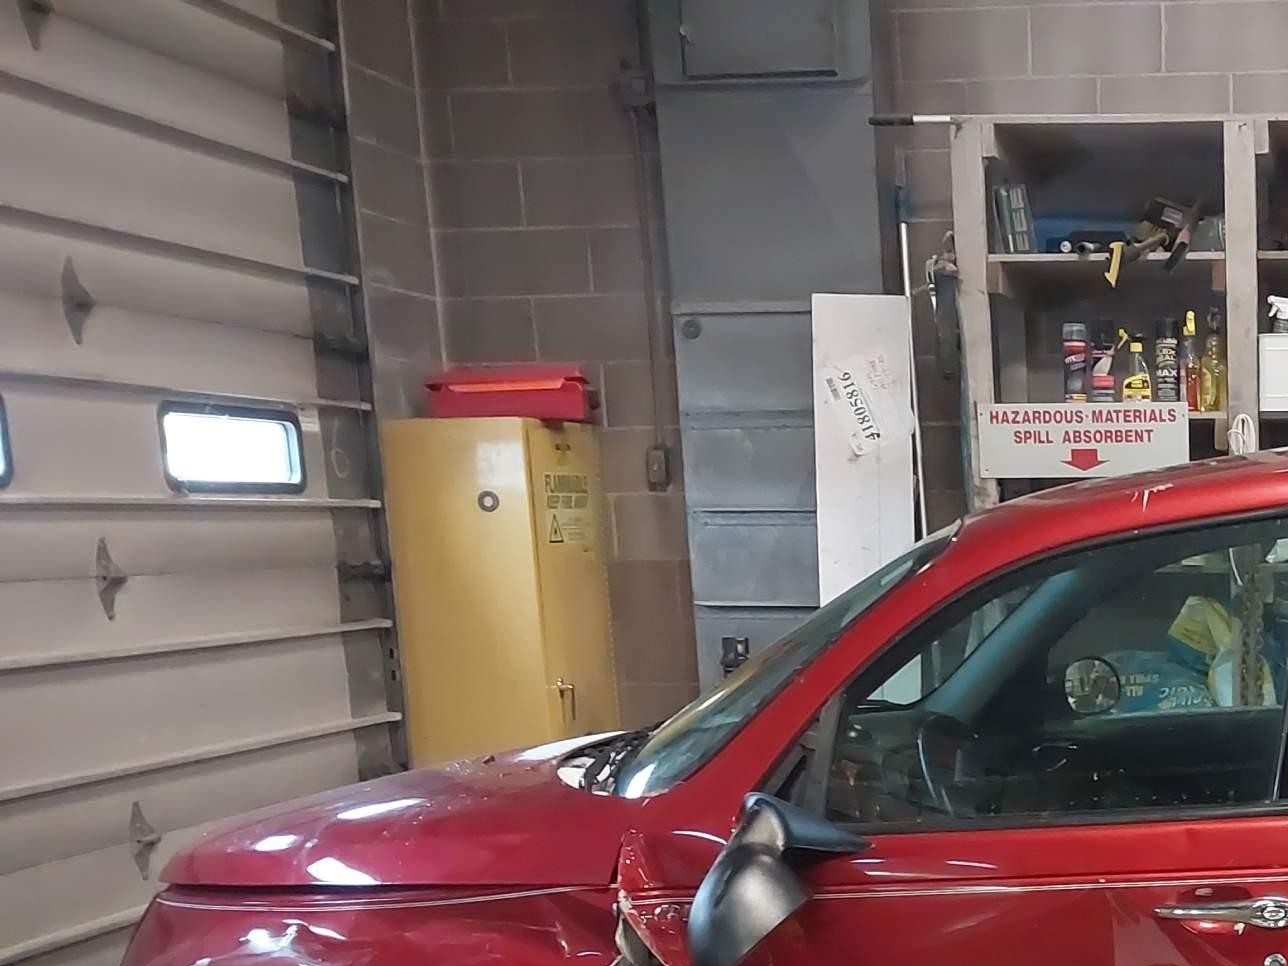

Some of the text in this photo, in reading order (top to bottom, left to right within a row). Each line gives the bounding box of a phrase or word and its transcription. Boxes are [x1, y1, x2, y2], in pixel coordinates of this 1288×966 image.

[989, 409, 1177, 424] HAZARDOUS MATERIALS
[1014, 429, 1154, 444] SPILL ABSORBENT
